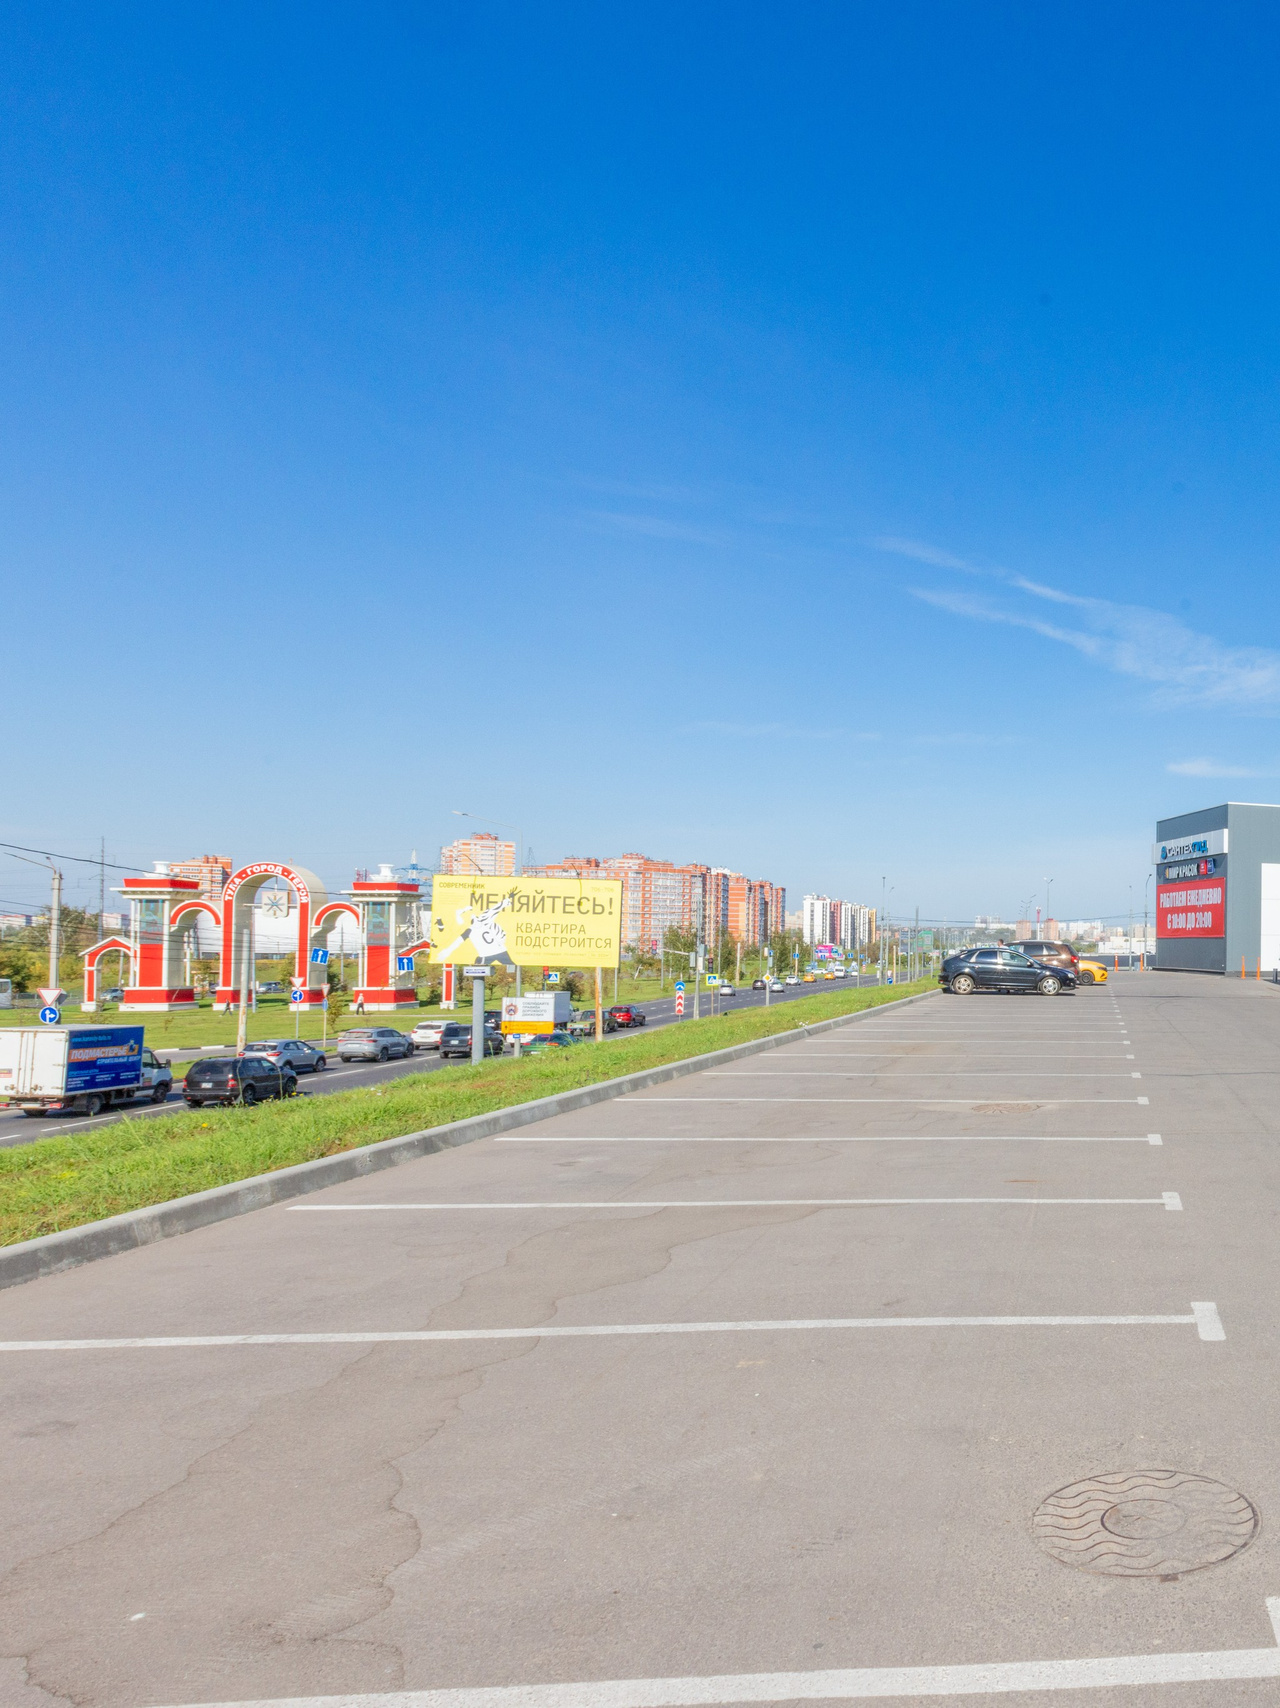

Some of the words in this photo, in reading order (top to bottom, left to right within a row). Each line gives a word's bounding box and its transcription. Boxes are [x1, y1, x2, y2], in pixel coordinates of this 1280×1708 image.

[225, 877, 242, 901] ТУЛА
[246, 865, 283, 875] ГОРОД
[439, 881, 485, 890] СОВРЕМЕННИК
[470, 889, 613, 916] МЕНЯЙТЕСЬ!
[1159, 890, 1187, 908] РАБОТАЕМ
[1187, 887, 1222, 908] ЕЖЕДНЕВНО
[516, 922, 587, 935] КВАРТИРА
[1167, 914, 1172, 929] С
[1172, 913, 1187, 929] 10:00
[1187, 912, 1196, 931] ДО
[1196, 911, 1212, 928] 20:00
[515, 936, 612, 949] ПОДСТРОИТСЯ
[71, 1046, 128, 1059] ПОДМАСТЕРЬЕ
